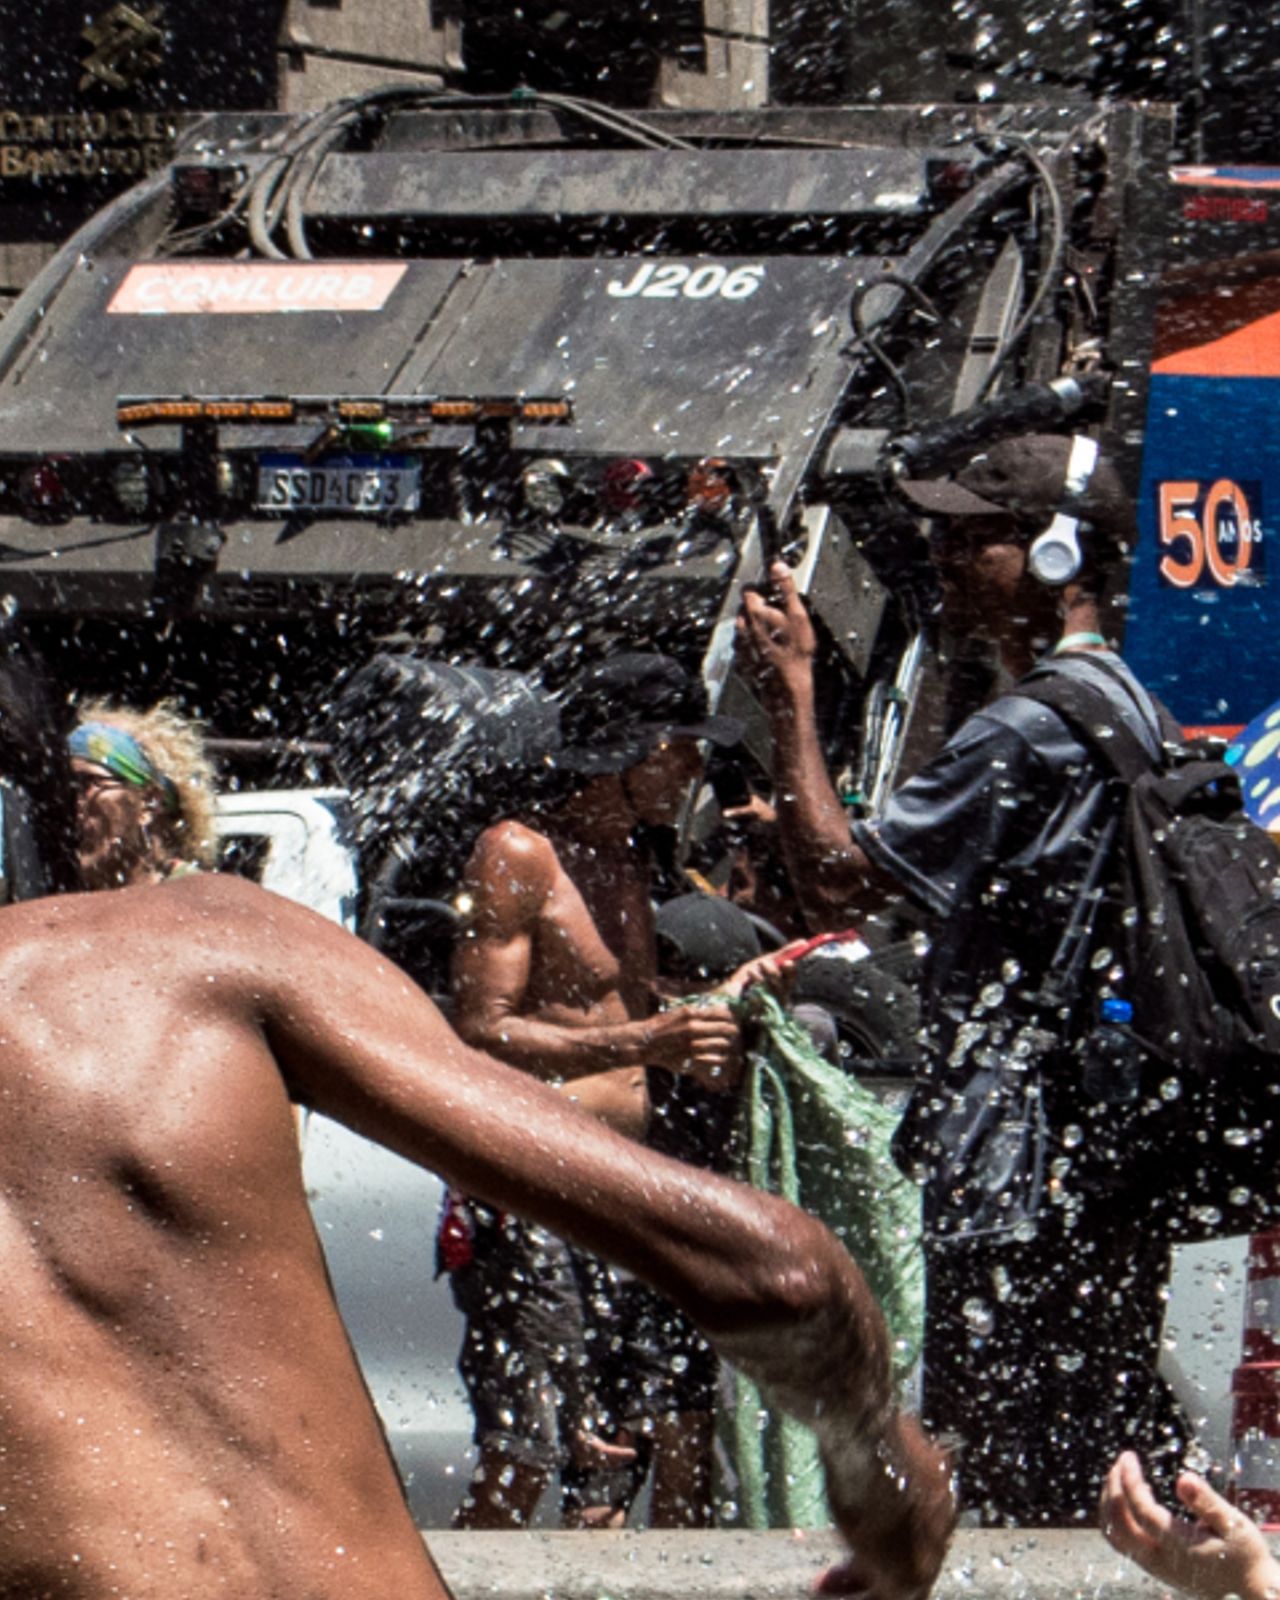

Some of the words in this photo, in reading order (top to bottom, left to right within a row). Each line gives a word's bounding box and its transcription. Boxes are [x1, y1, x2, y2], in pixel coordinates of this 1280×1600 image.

[137, 274, 376, 301] COMLURB
[606, 263, 765, 299] J206
[1159, 478, 1252, 588] 50
